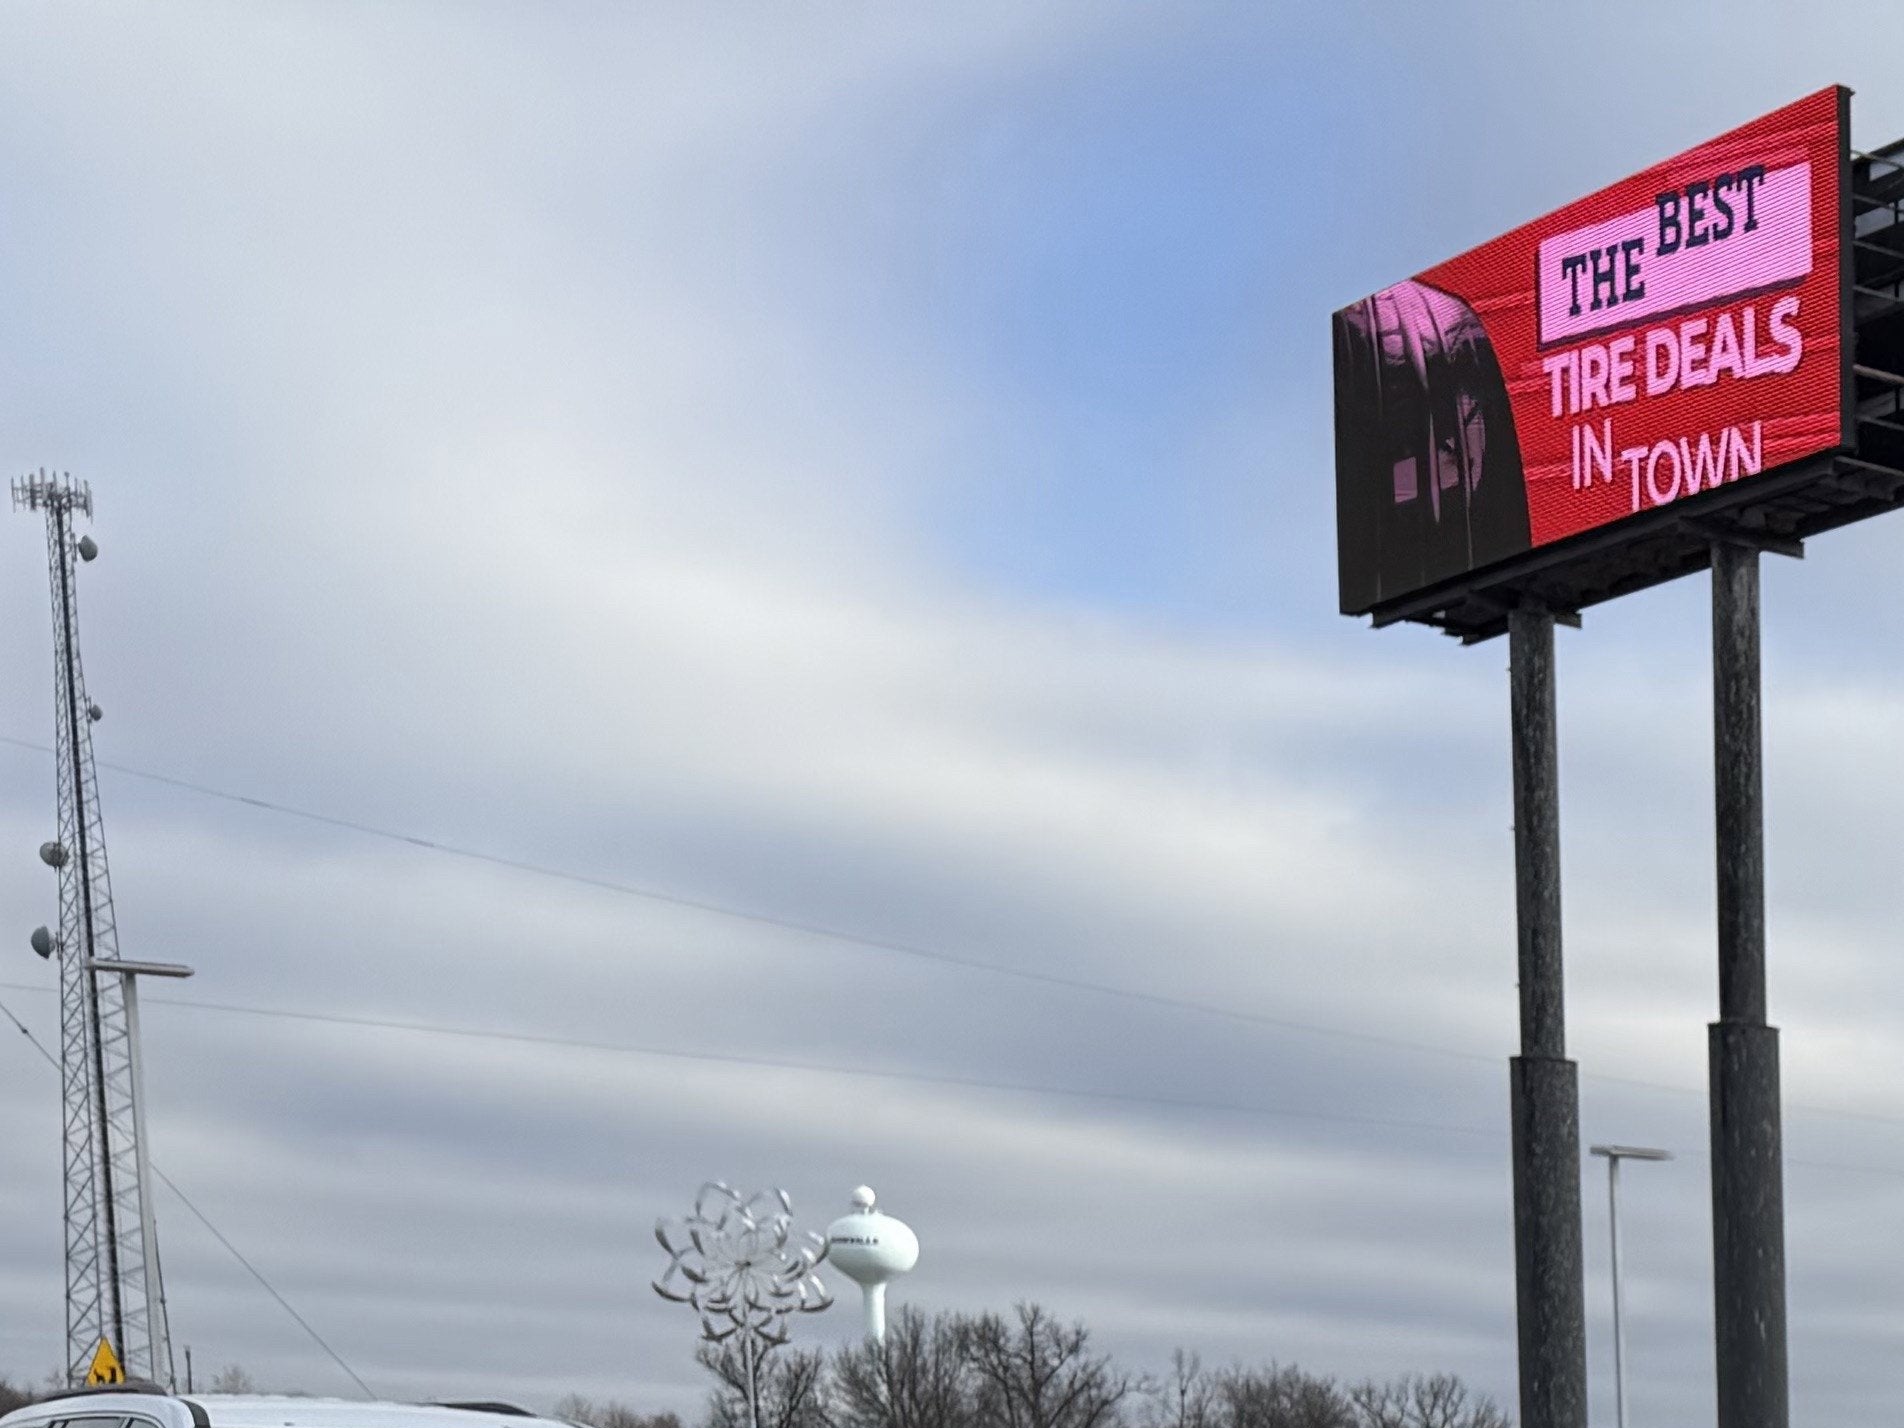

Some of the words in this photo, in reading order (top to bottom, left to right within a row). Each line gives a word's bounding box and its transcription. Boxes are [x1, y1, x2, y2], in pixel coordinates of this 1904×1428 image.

[1562, 239, 1646, 317] THE
[1655, 166, 1765, 256] BEST
[1543, 339, 1637, 418] TIRE
[1645, 296, 1801, 394] DEALS
[1572, 417, 1613, 490] IN
[1621, 420, 1763, 513] TOWN
